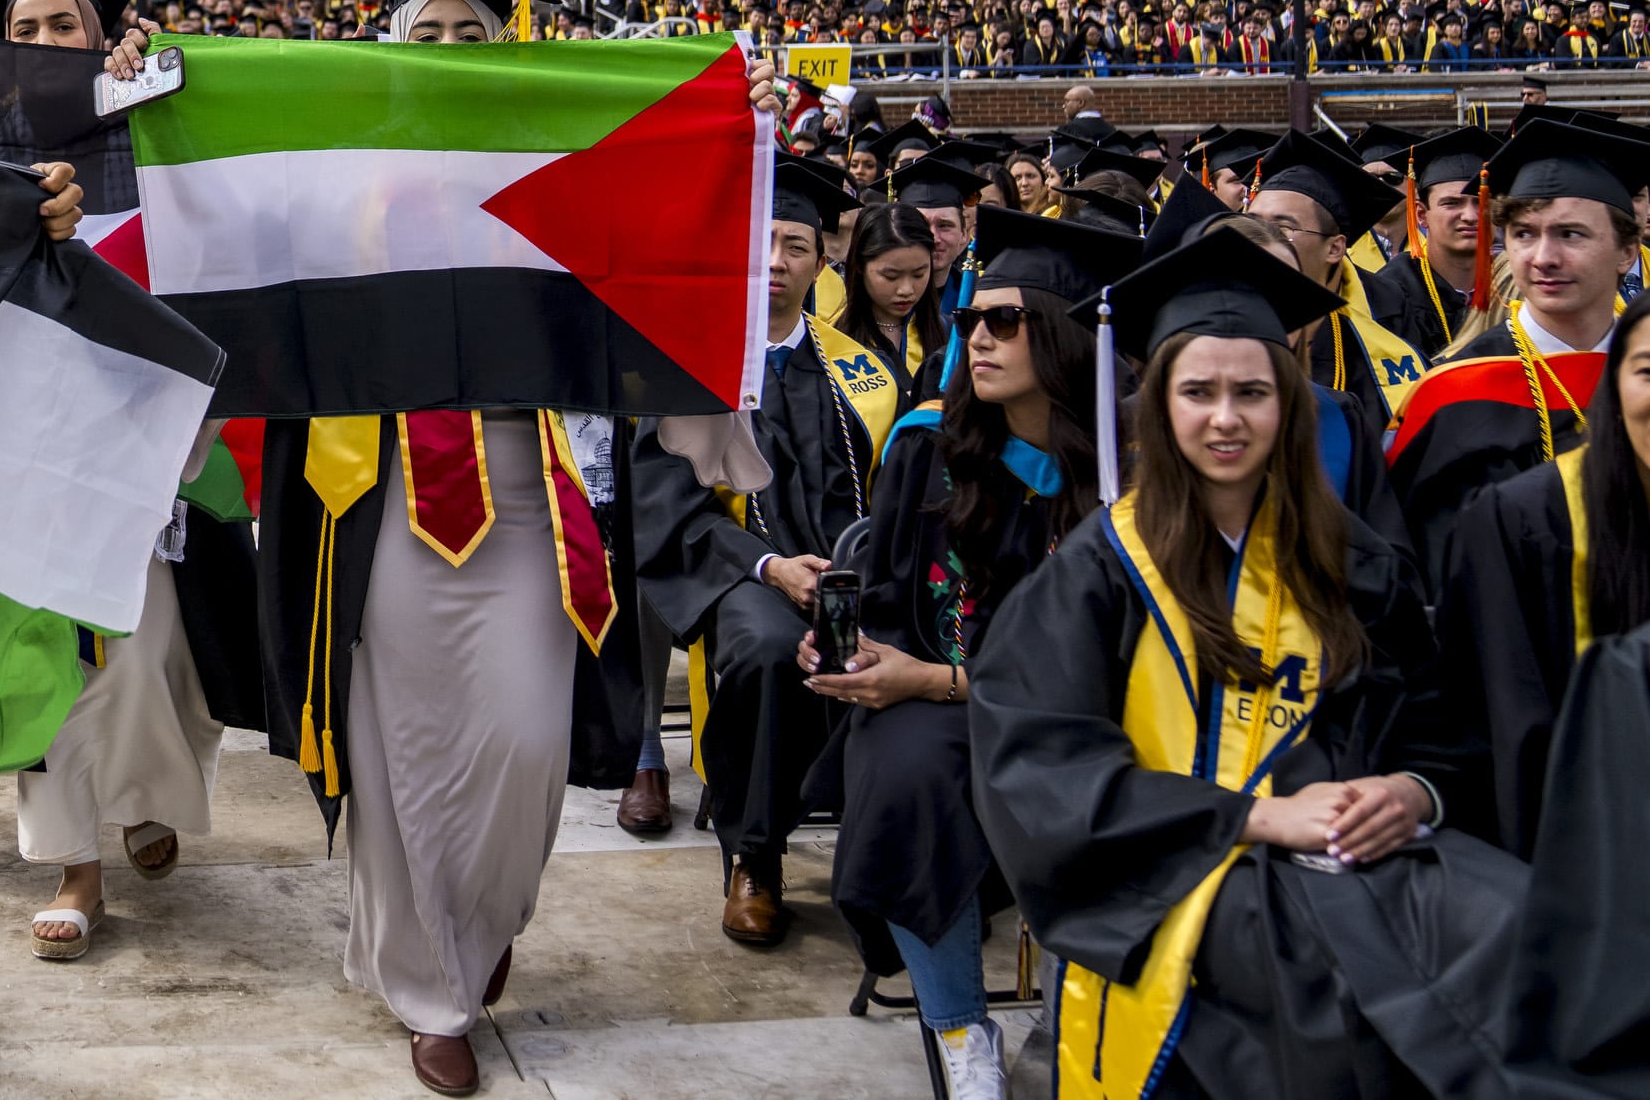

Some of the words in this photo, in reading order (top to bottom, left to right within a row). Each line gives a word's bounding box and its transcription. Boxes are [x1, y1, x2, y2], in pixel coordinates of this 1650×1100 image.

[798, 60, 839, 78] EXIT
[832, 353, 879, 381] M
[1380, 354, 1421, 386] M
[848, 375, 888, 394] ROSS
